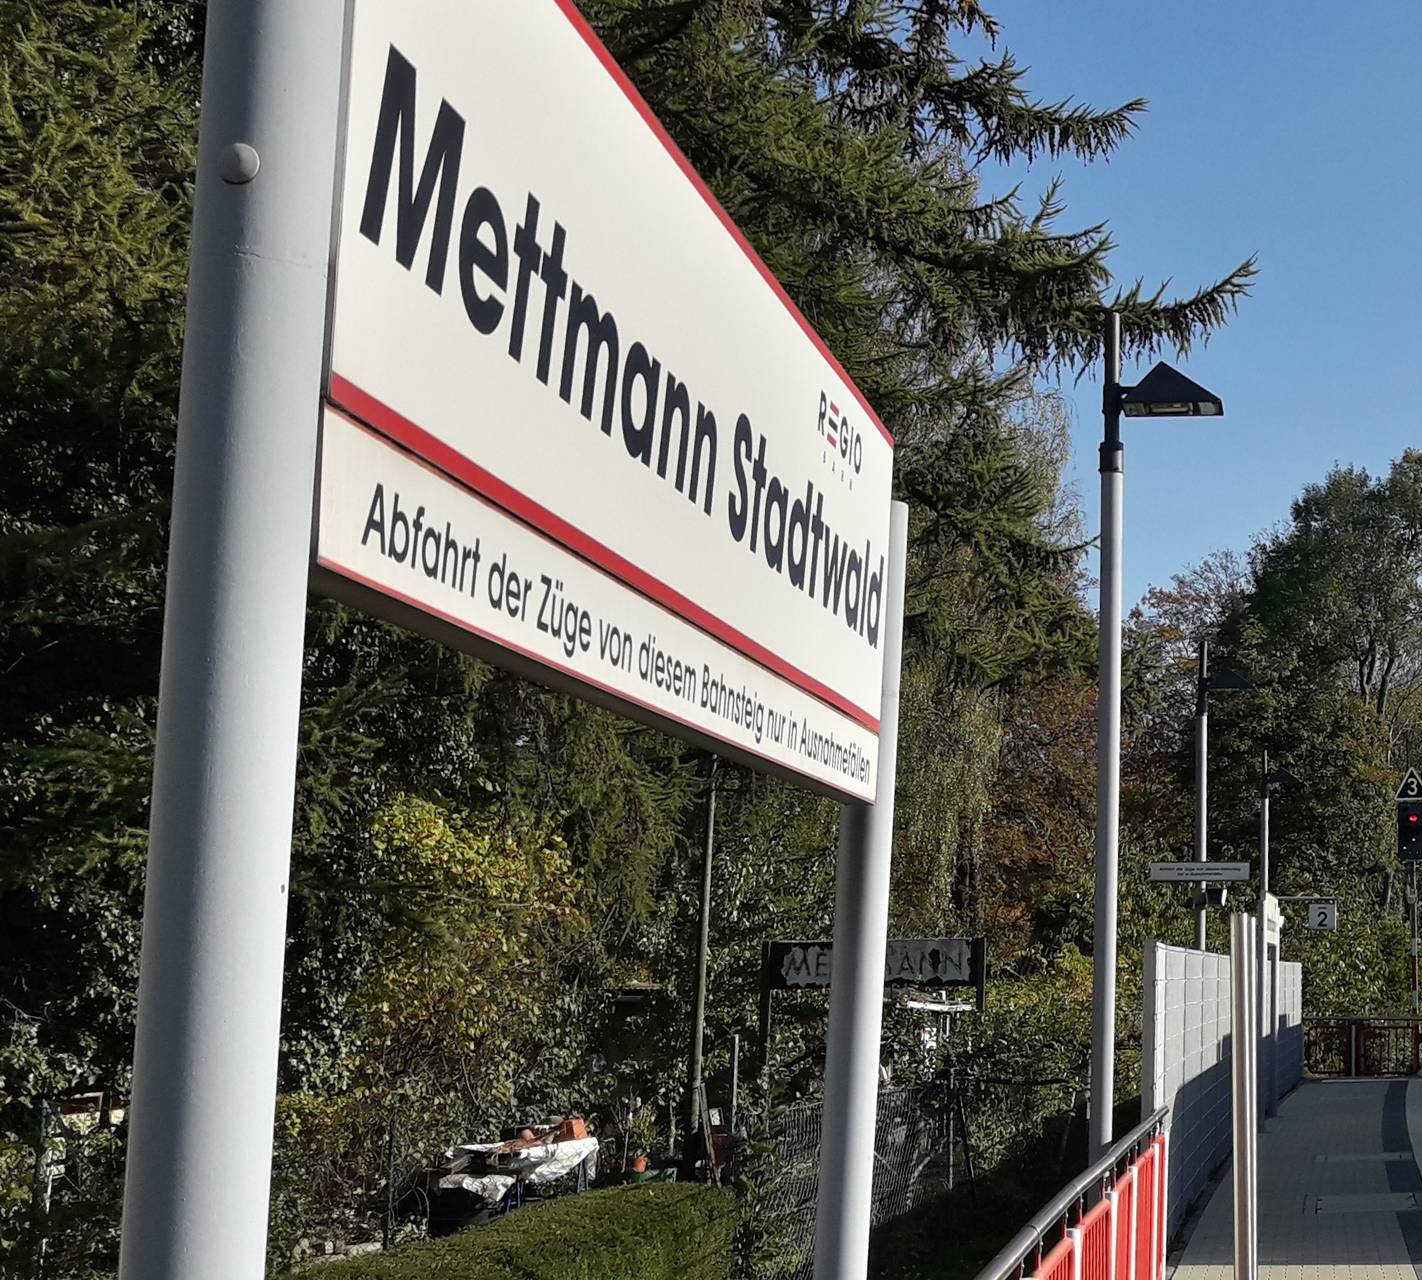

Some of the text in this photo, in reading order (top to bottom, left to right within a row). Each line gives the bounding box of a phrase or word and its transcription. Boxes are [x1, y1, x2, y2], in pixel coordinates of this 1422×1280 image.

[359, 42, 884, 650] Mettmann Stadtwald
[817, 389, 862, 475] REGIO
[361, 482, 871, 785] Abfahrt der Züge von diesem Bahnsteig nur in Ausnahmefällen
[1407, 778, 1418, 796] 3
[1317, 911, 1328, 927] 2
